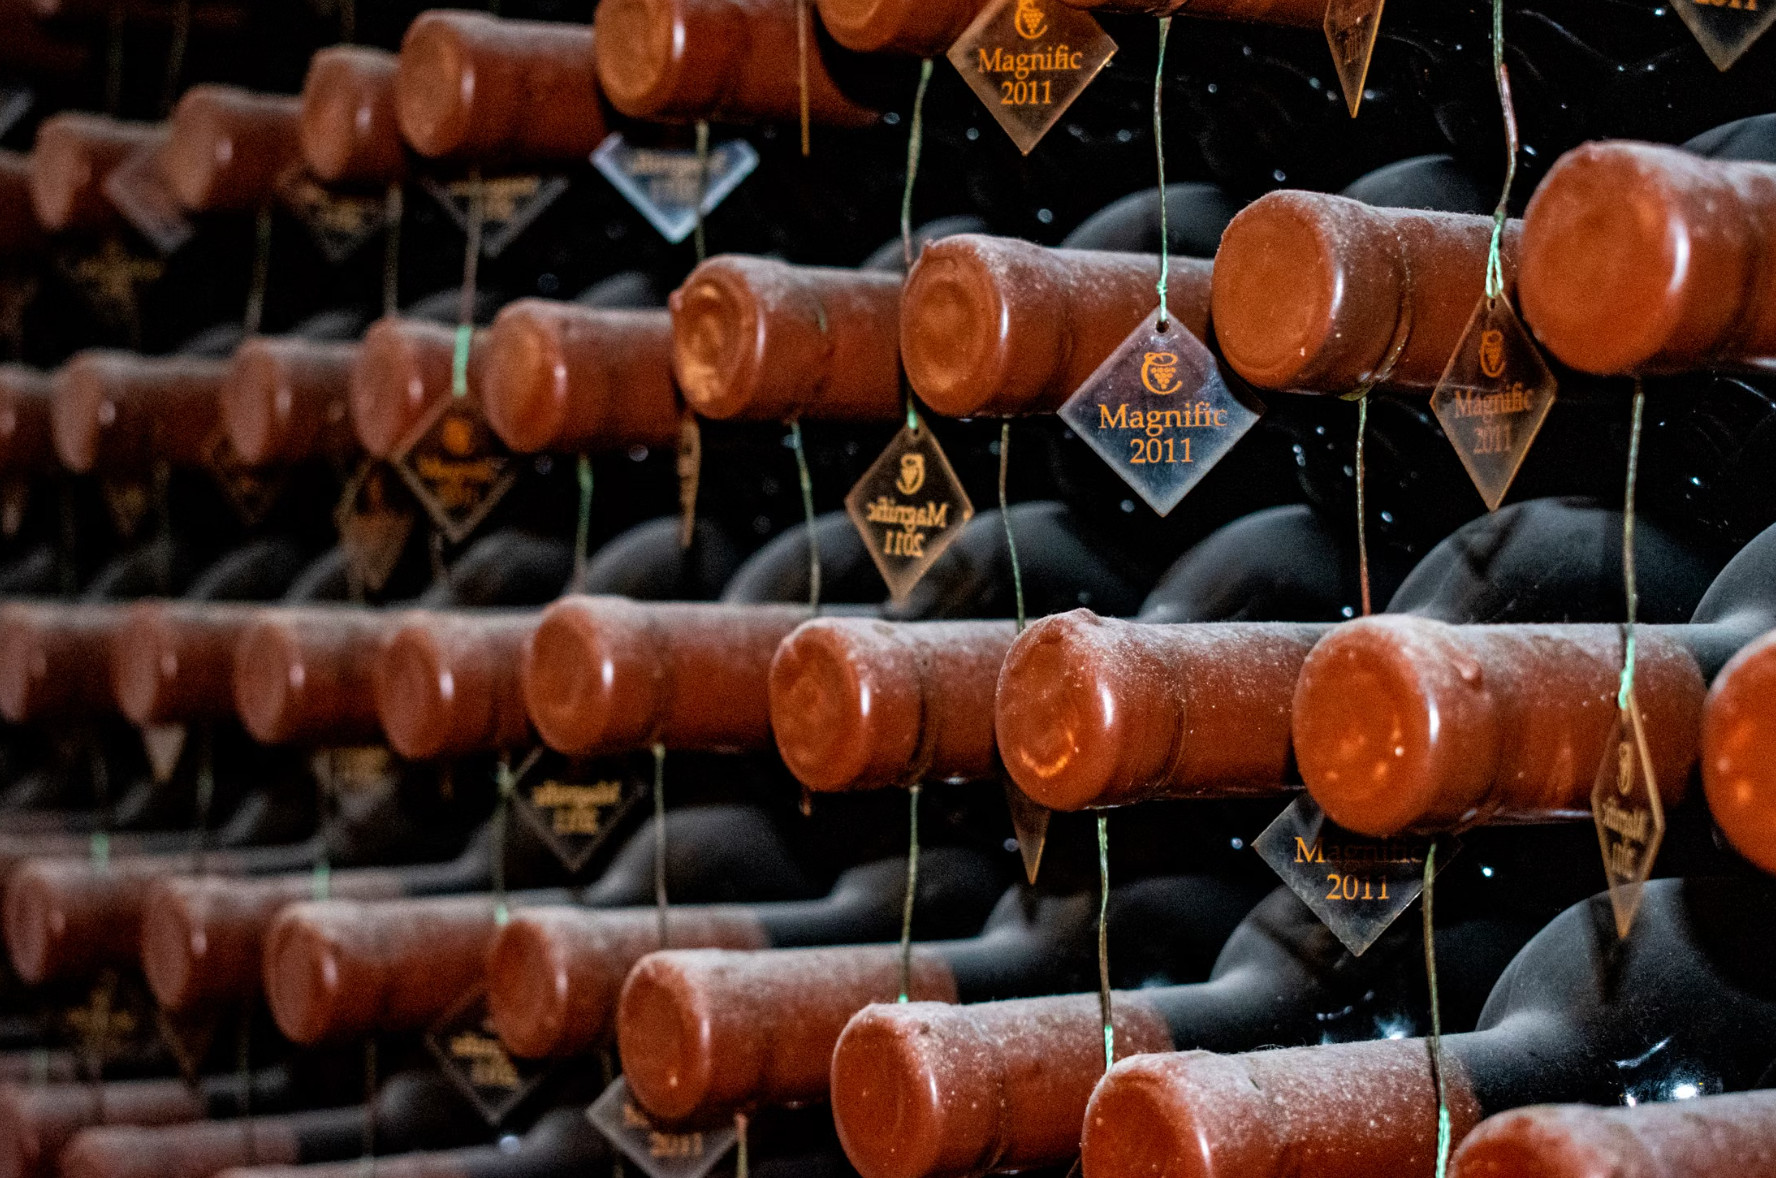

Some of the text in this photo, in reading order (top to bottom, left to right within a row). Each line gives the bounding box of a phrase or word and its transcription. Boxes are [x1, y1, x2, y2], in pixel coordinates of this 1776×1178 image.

[978, 45, 1083, 80] Magnific
[1000, 80, 1051, 105] 2011
[1454, 382, 1535, 424] Magnific
[1098, 402, 1228, 437] Magnific
[1130, 438, 1193, 463] 2011
[1473, 424, 1512, 453] 2011
[1325, 873, 1391, 900] 2011
